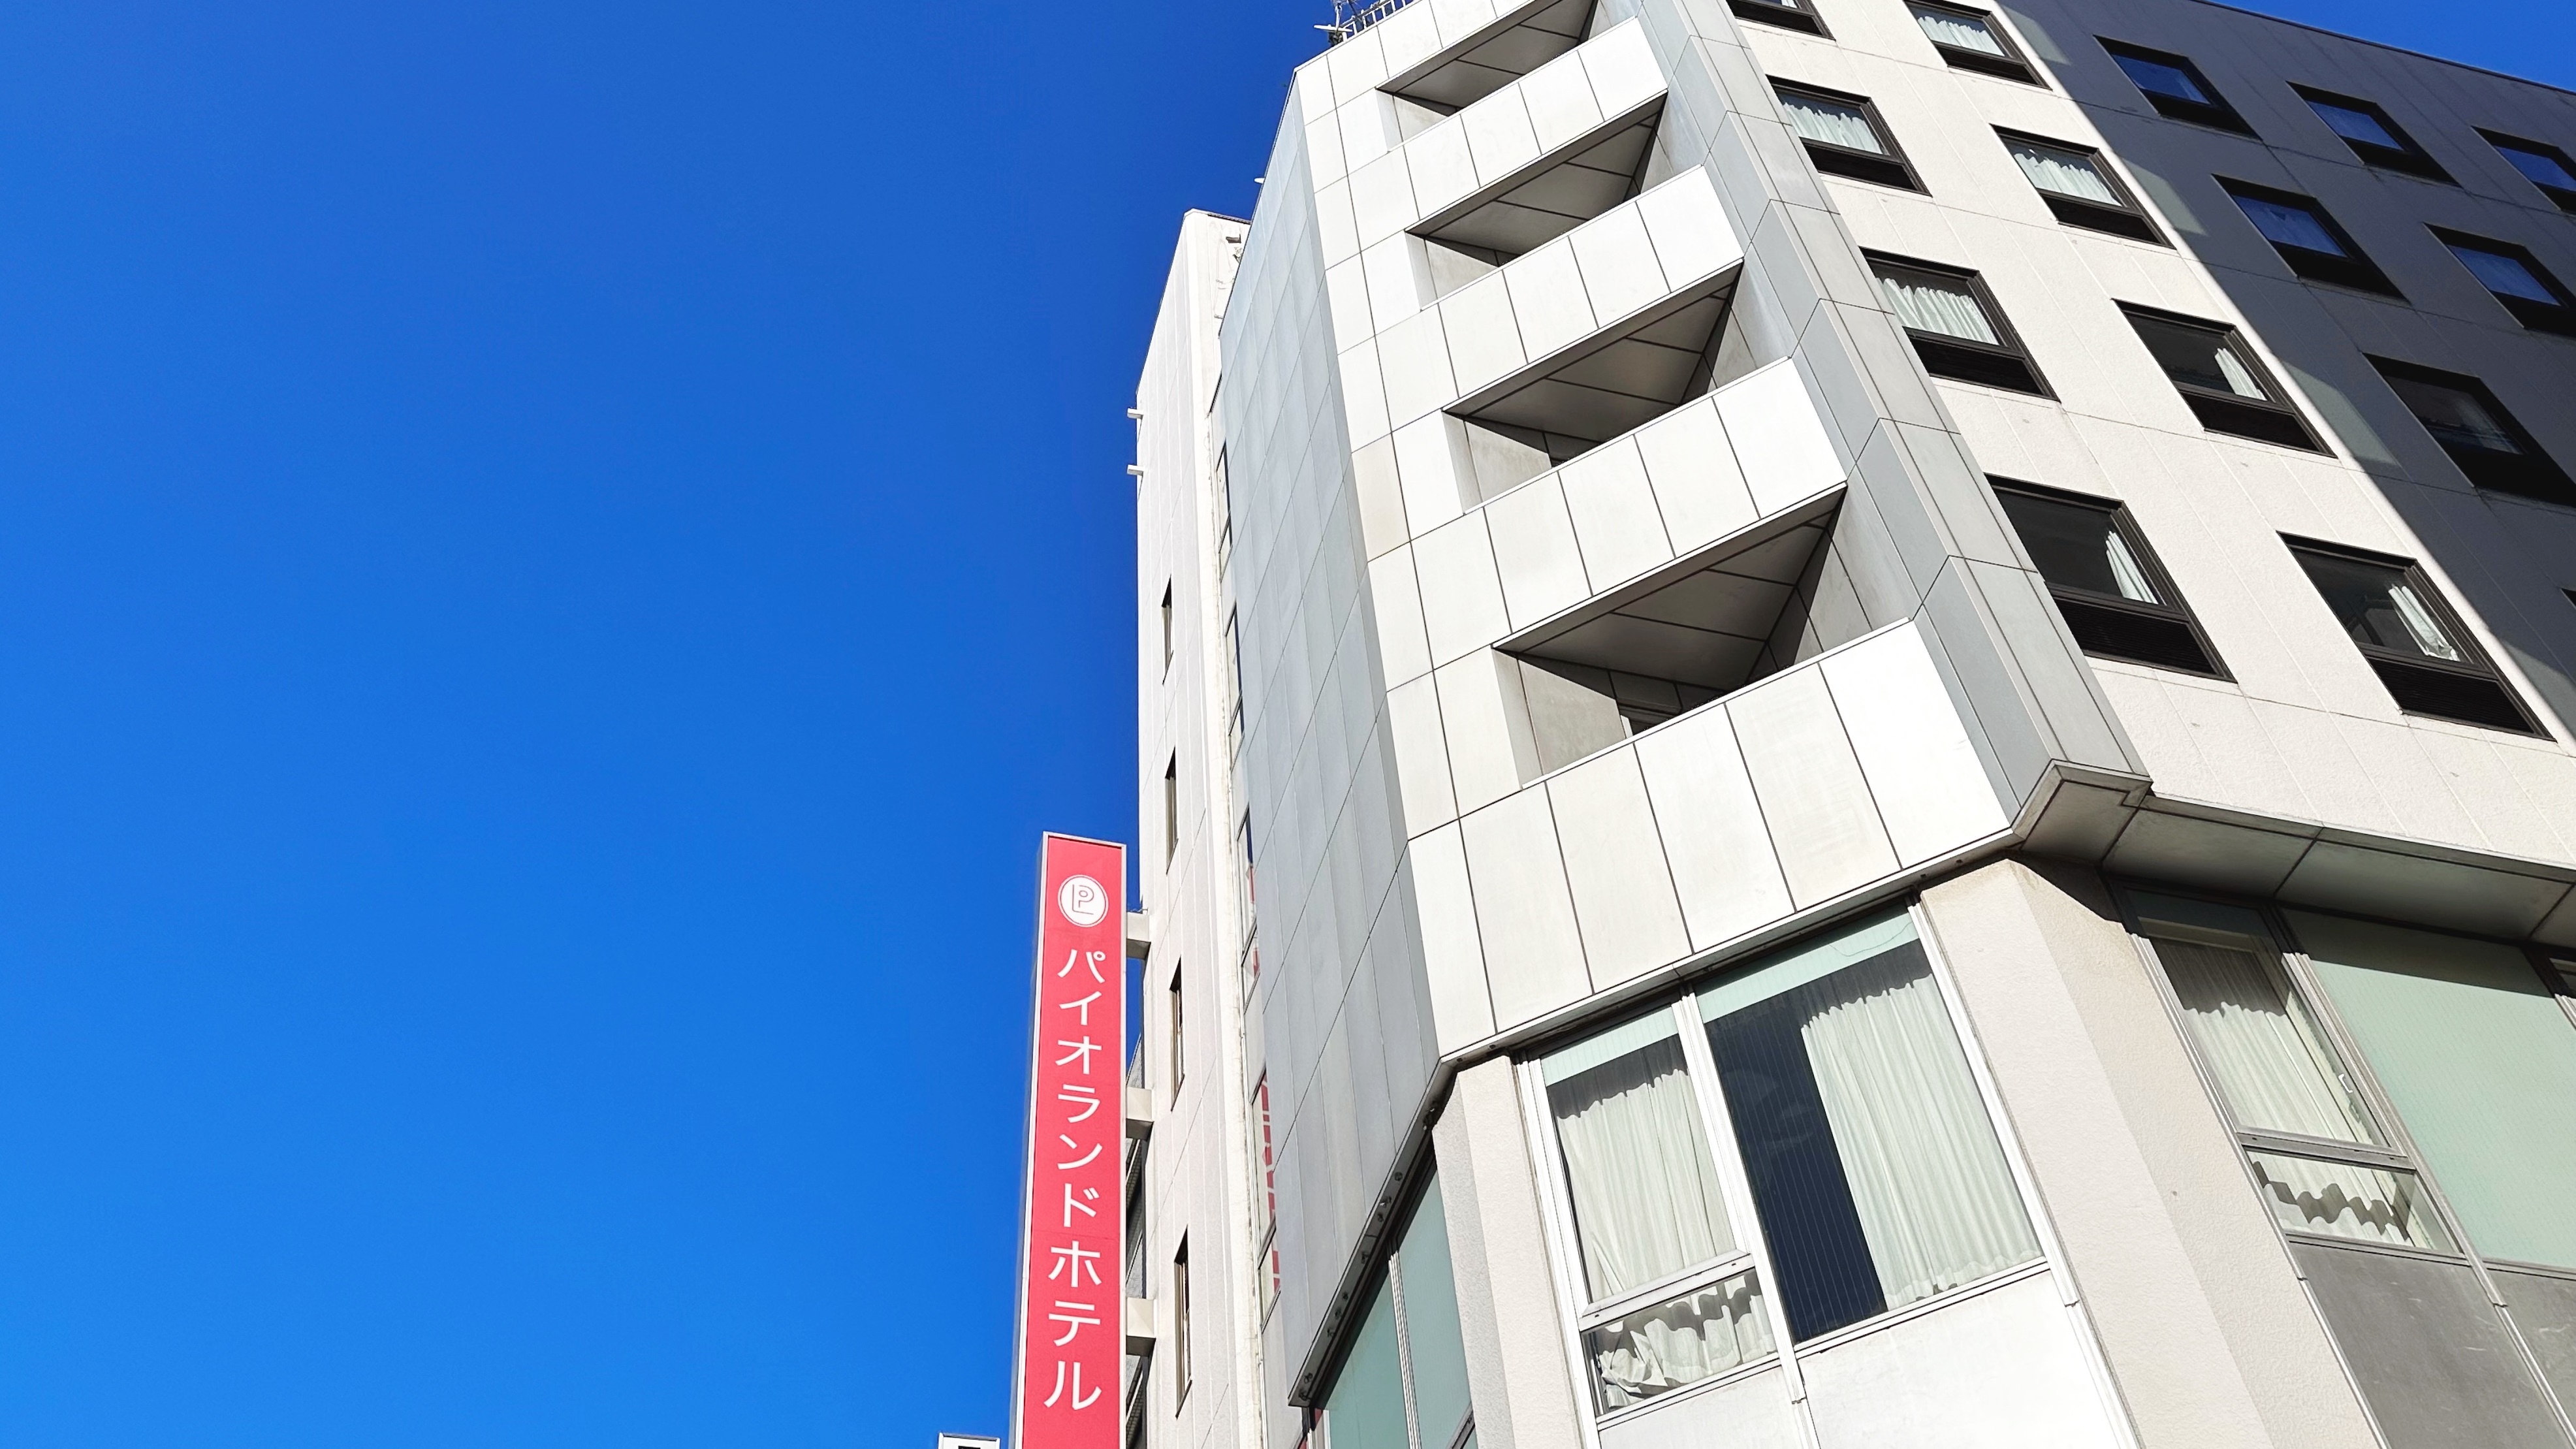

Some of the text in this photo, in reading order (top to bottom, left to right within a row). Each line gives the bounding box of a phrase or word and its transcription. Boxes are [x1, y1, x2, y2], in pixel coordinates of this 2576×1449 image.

[1043, 948, 1107, 1411] パイオランドホテル
